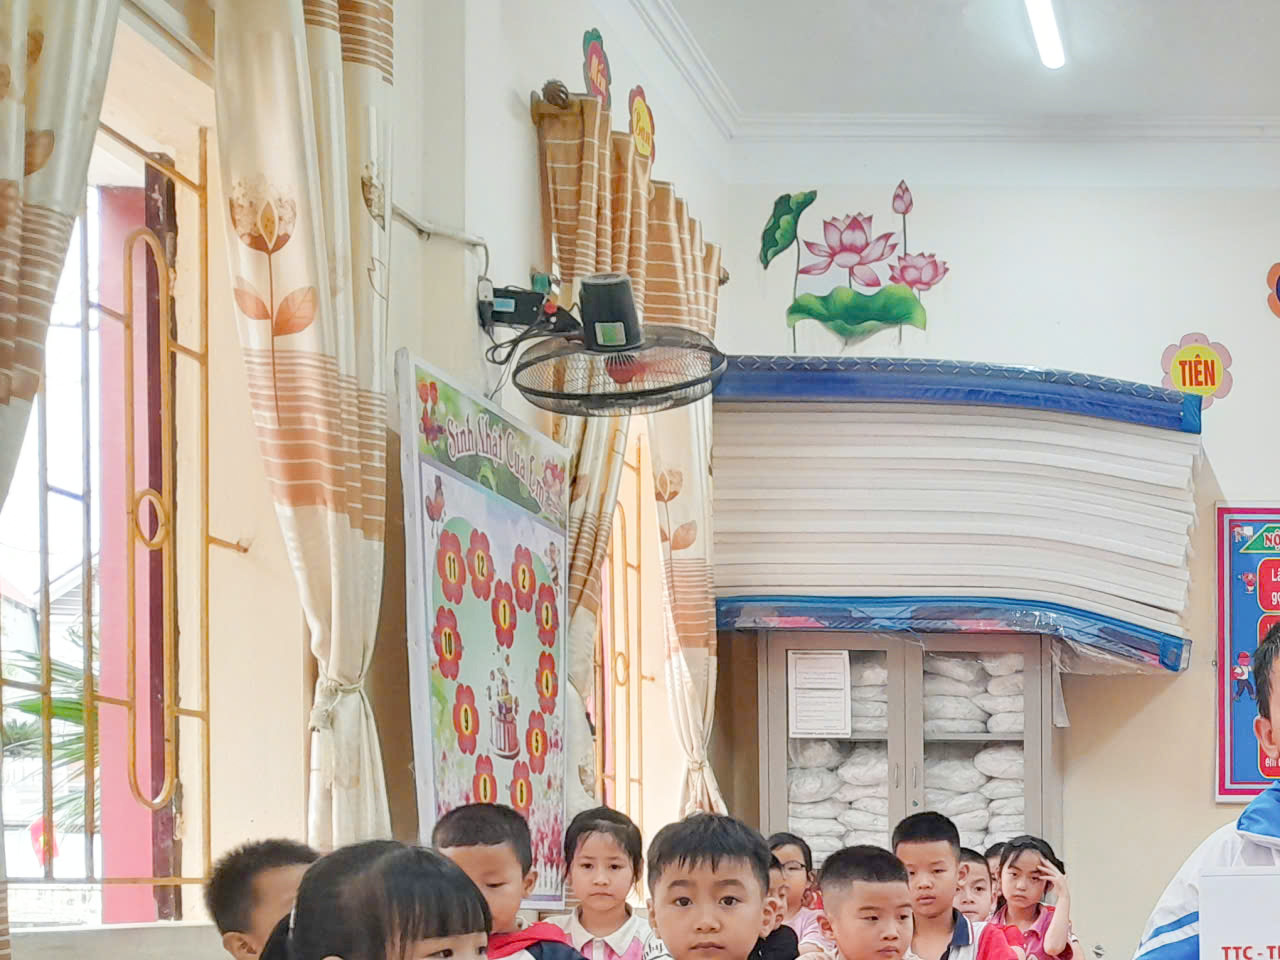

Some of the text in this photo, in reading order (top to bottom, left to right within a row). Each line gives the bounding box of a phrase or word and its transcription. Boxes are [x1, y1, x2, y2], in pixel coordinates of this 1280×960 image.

[1178, 353, 1216, 387] TIÊN
[476, 553, 485, 578] 12
[1221, 946, 1254, 960] TTC
